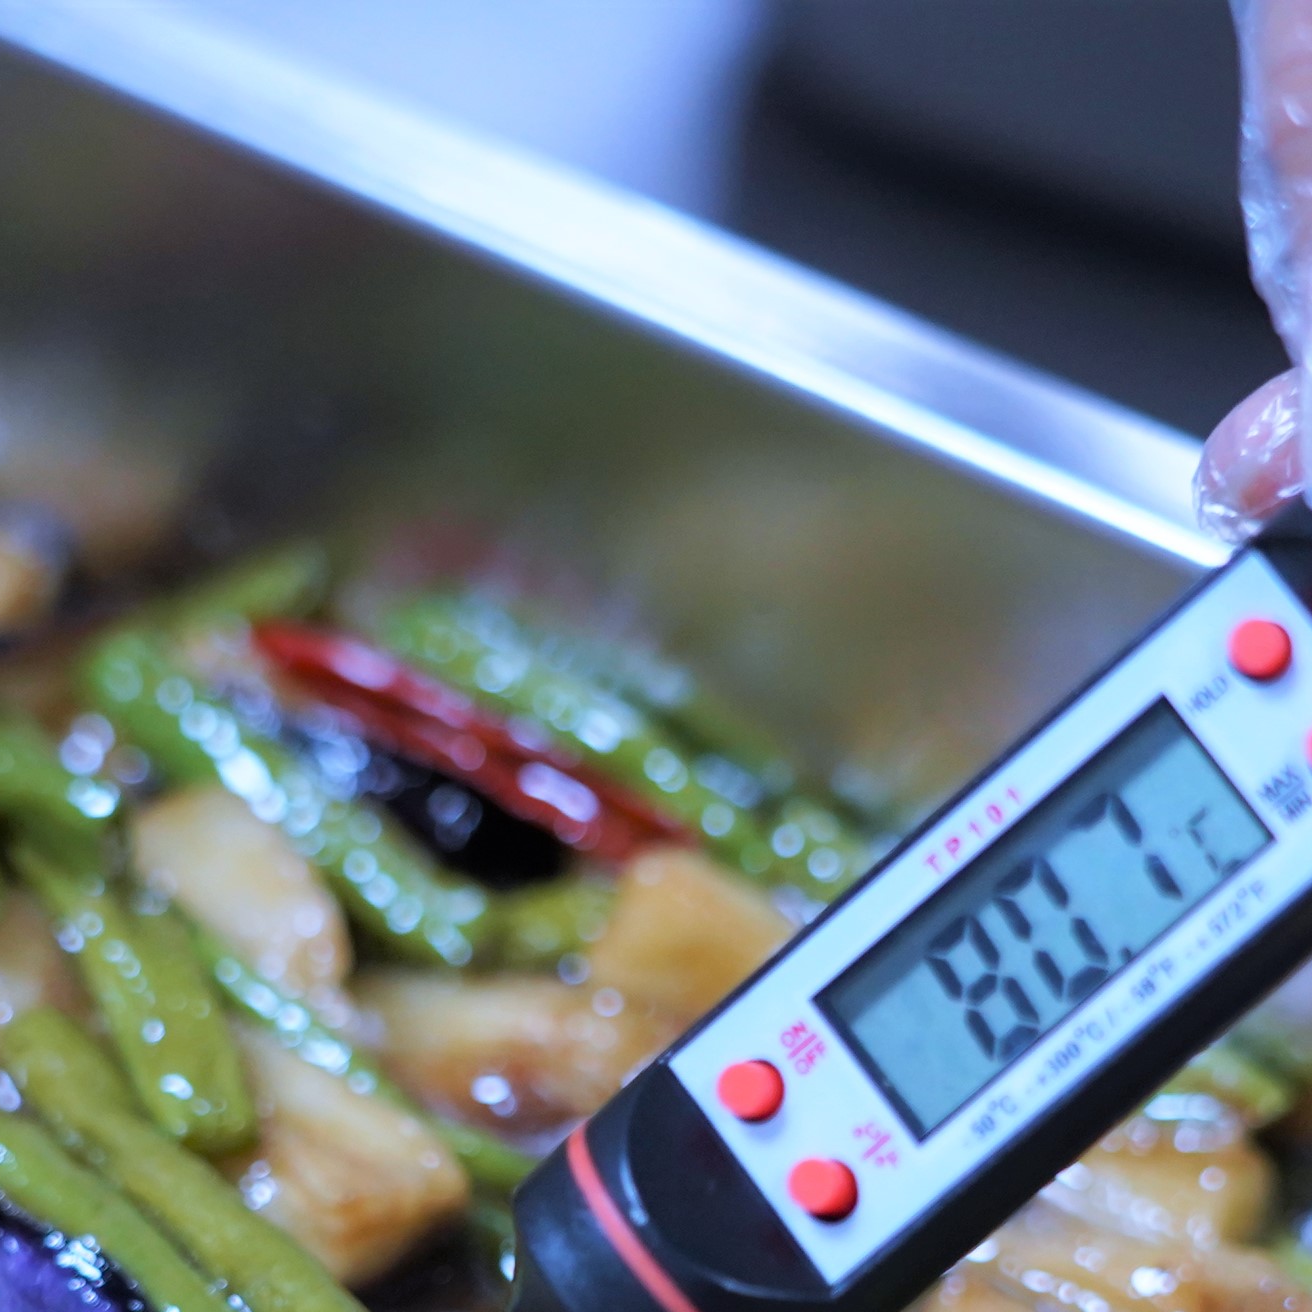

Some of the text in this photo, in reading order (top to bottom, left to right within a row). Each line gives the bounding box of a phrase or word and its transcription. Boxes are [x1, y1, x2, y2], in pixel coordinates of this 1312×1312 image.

[1187, 674, 1229, 715] HOLD
[1259, 764, 1304, 802] MAX
[923, 787, 1022, 874] TP101
[780, 1021, 807, 1049] ON
[794, 1040, 826, 1075] OFF
